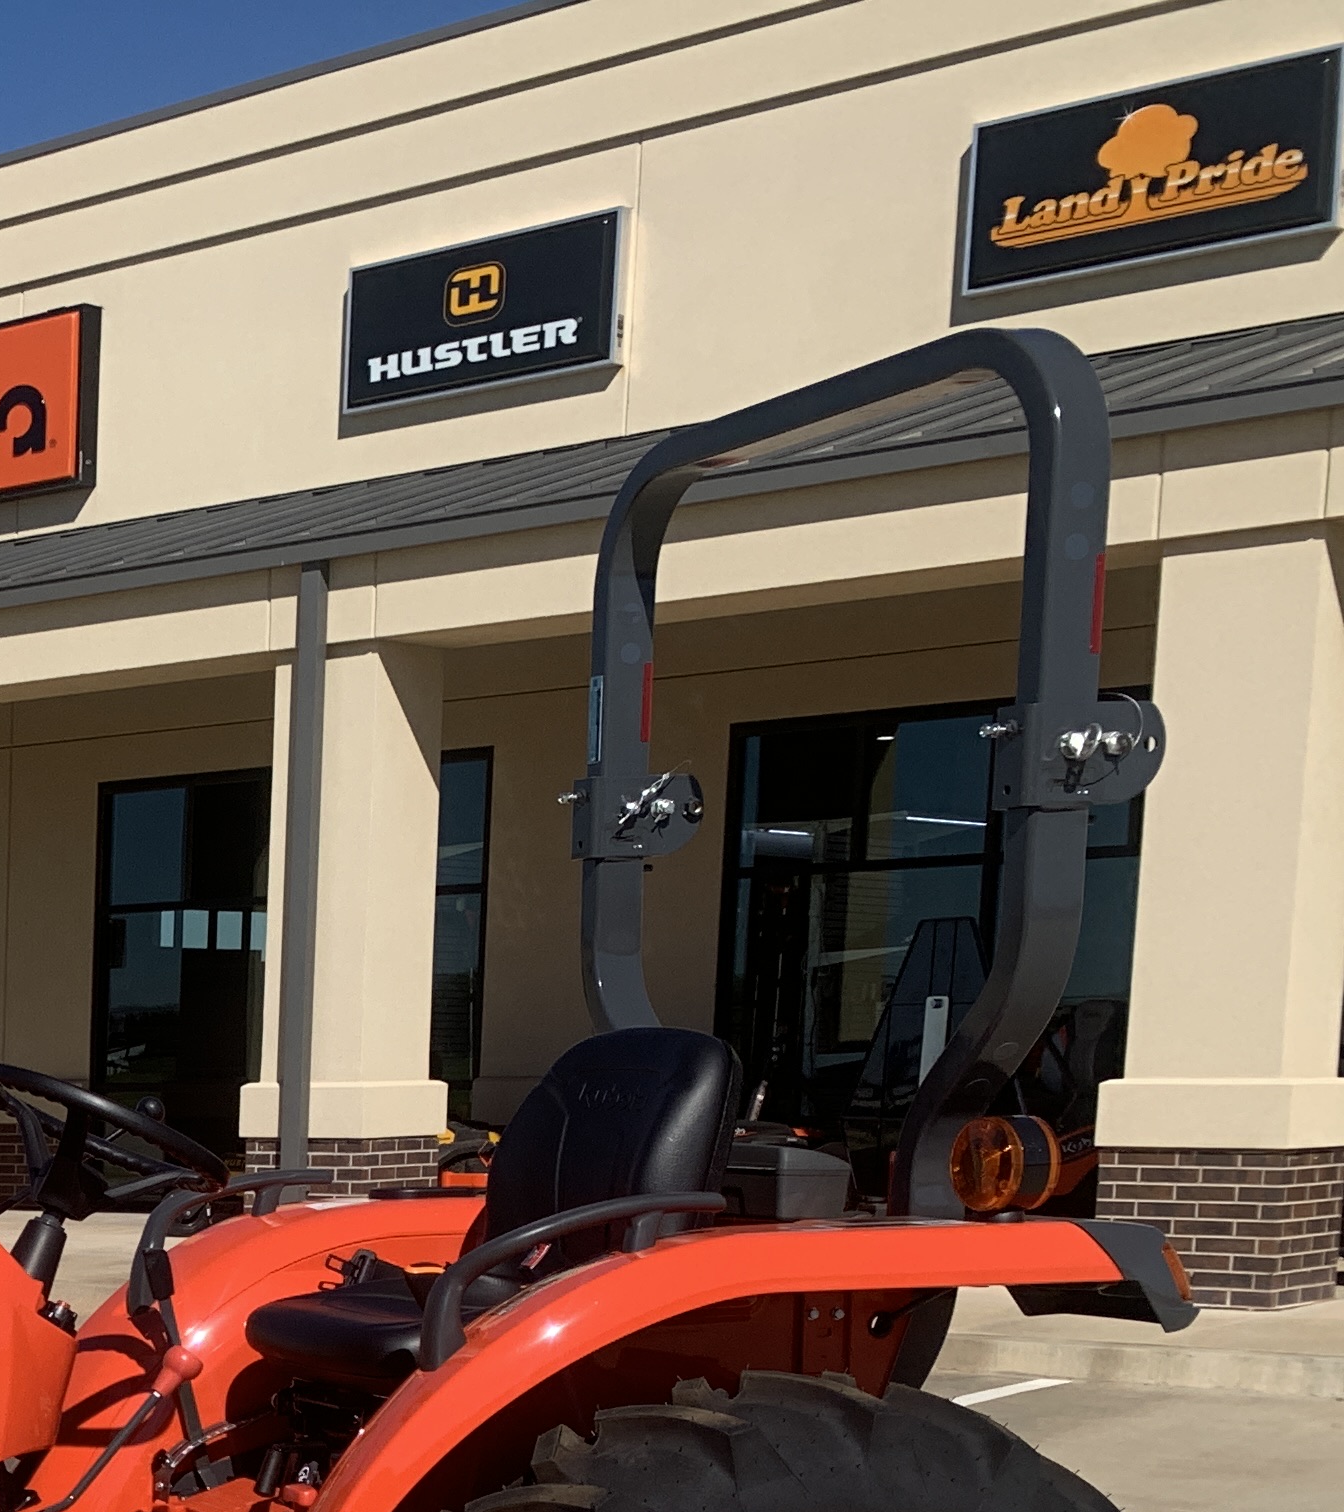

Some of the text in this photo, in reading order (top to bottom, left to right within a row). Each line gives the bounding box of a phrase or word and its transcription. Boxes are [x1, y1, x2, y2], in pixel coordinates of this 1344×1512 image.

[998, 143, 1304, 235] Land Pride
[368, 317, 579, 383] HUSTLER
